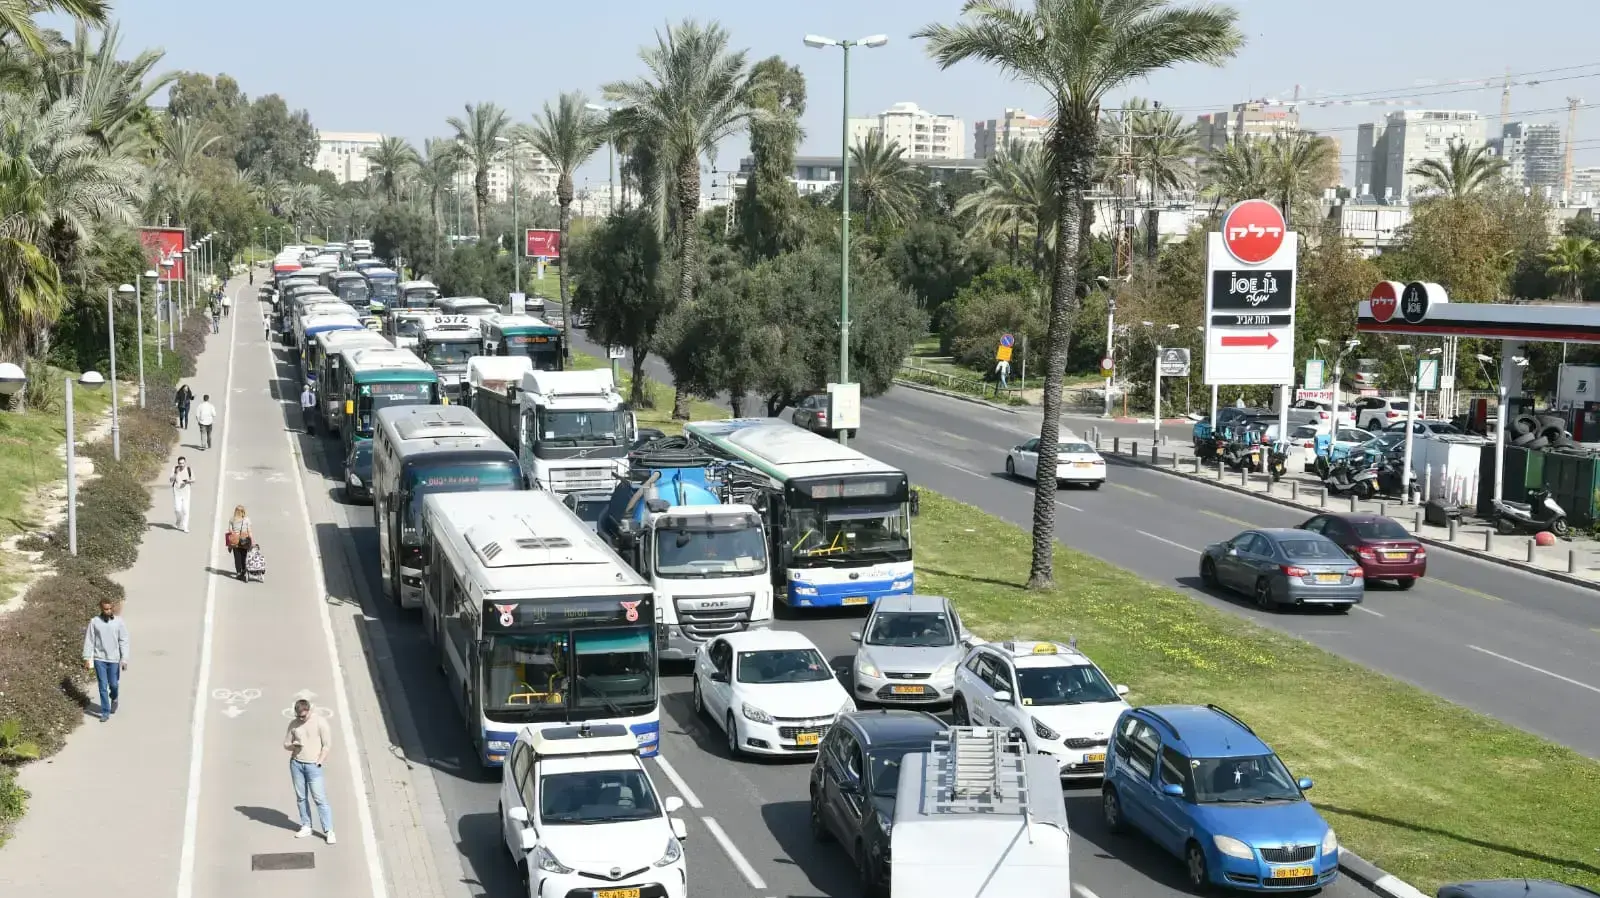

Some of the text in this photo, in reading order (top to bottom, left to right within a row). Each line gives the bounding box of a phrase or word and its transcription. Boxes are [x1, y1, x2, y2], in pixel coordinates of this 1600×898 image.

[1229, 223, 1281, 241] דלק
[434, 315, 469, 324] 8372
[1236, 315, 1270, 325] רמת אביב
